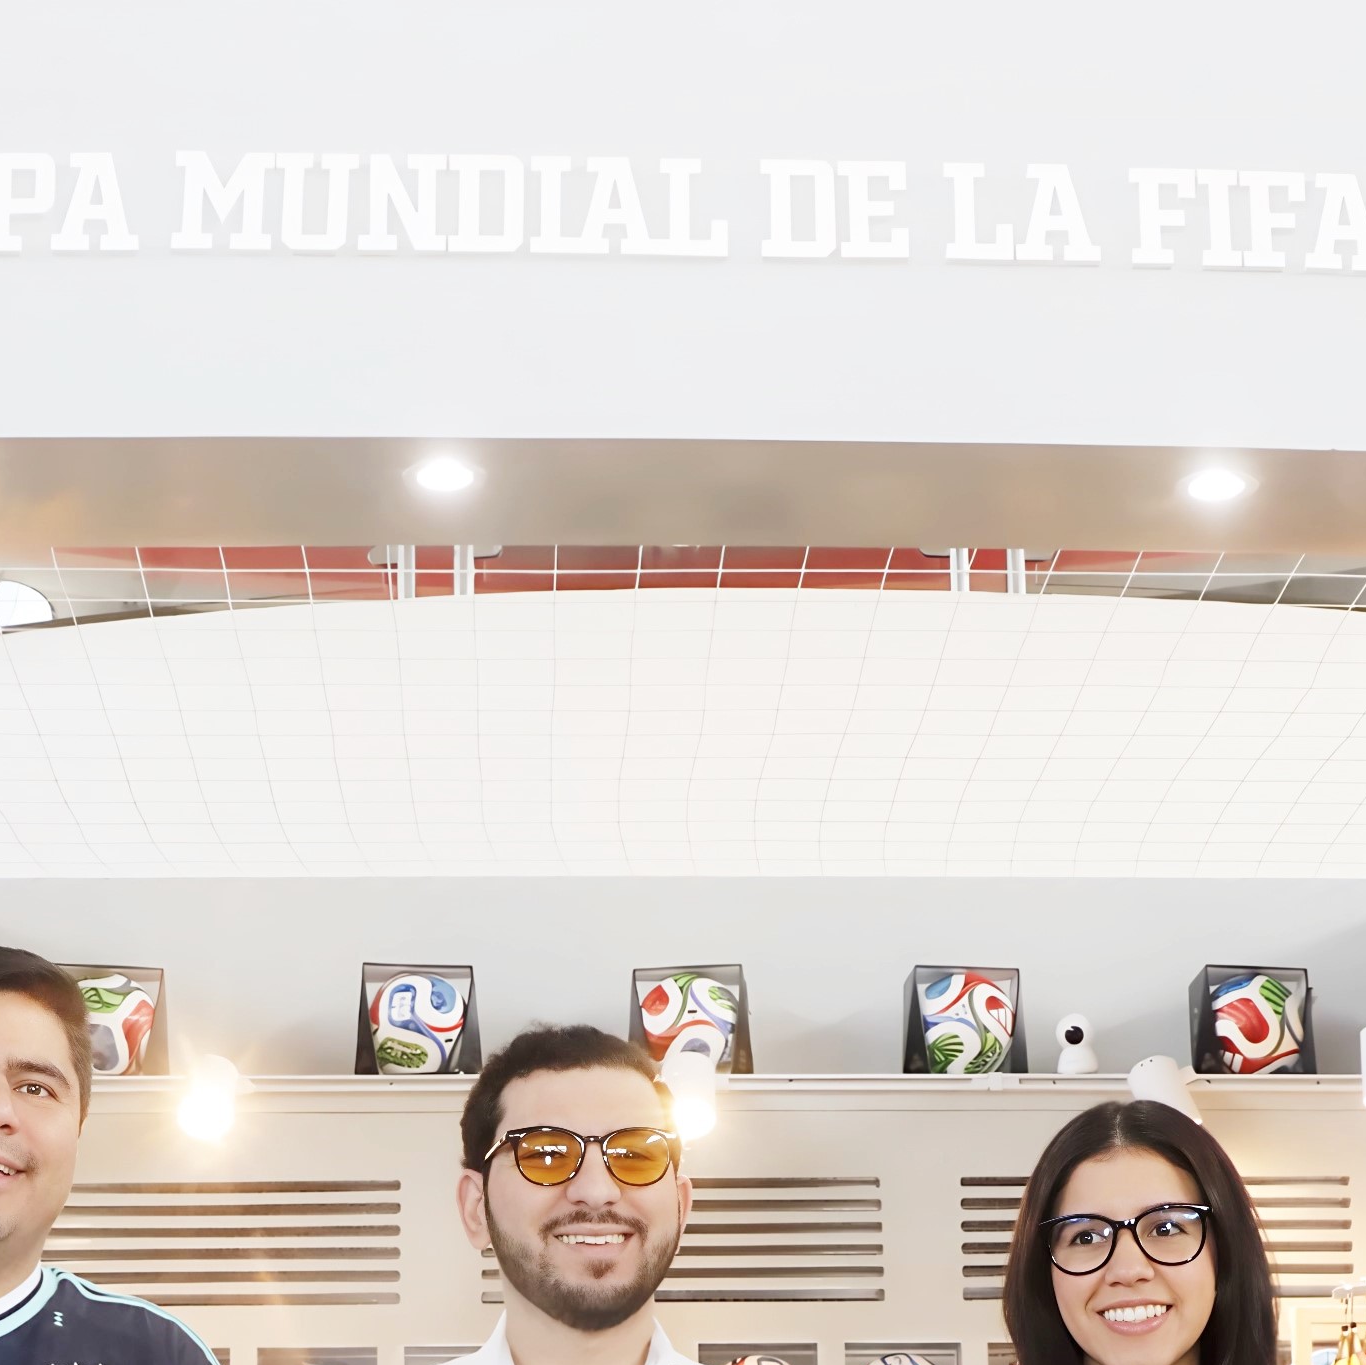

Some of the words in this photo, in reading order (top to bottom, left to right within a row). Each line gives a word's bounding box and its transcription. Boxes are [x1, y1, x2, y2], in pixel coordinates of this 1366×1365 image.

[171, 150, 729, 258] MUNDIAL
[760, 158, 909, 261] DE
[944, 162, 1102, 266] LA
